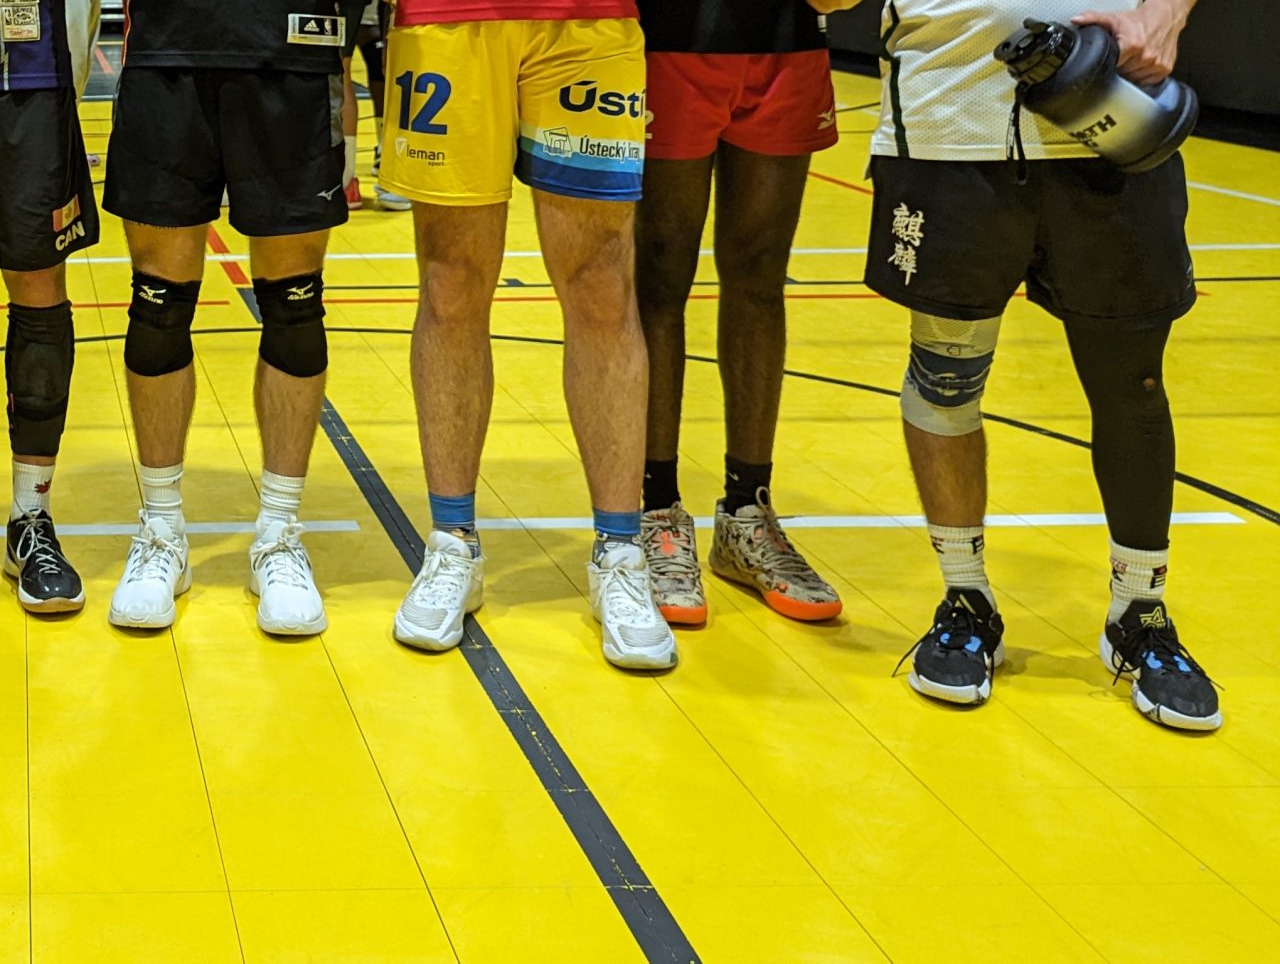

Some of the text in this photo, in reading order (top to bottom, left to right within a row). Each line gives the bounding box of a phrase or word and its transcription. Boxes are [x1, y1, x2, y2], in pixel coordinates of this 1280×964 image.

[395, 70, 452, 135] 12
[406, 142, 446, 162] leman
[580, 134, 628, 163] Ústecký
[55, 220, 86, 252] CAN
